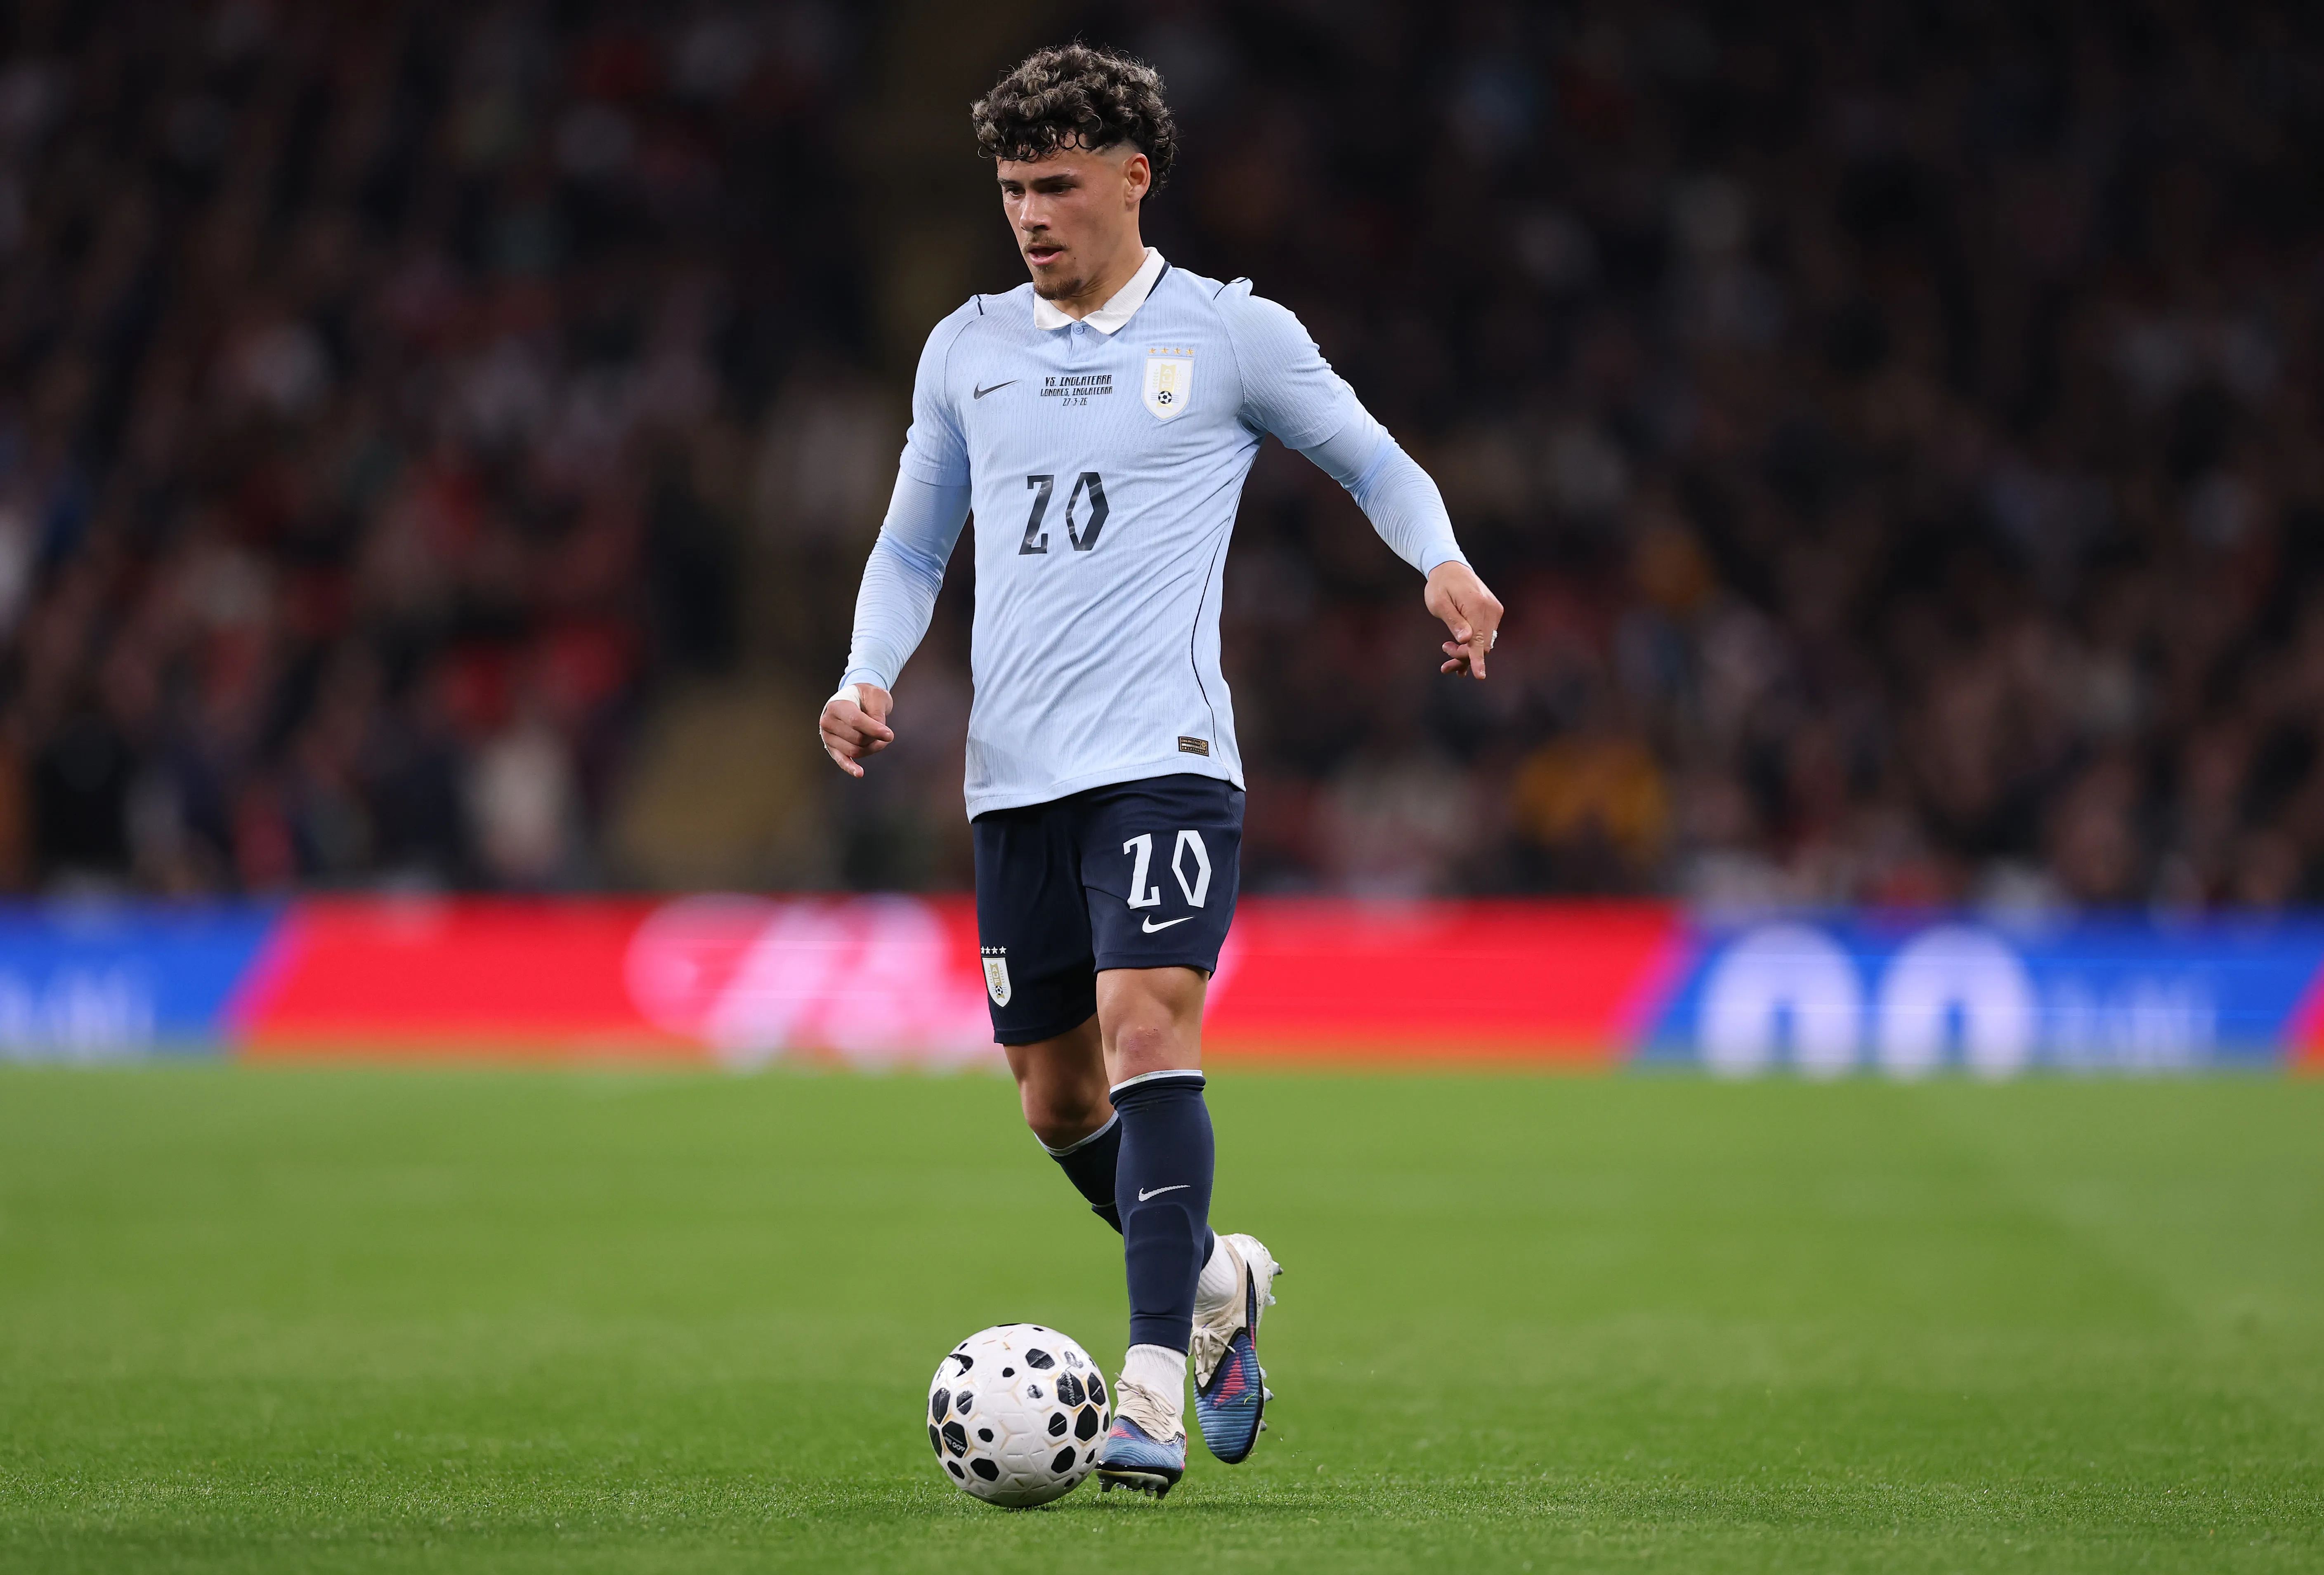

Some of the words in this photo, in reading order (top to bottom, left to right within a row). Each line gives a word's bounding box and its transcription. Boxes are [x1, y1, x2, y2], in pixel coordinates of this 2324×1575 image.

[1040, 388, 1070, 396] LONDRES,
[1072, 386, 1113, 396] INGLATERRA
[1045, 377, 1056, 387] VS.
[1059, 375, 1112, 387] INGLATERRA
[1018, 472, 1110, 555] 20
[1123, 830, 1212, 909] 20
